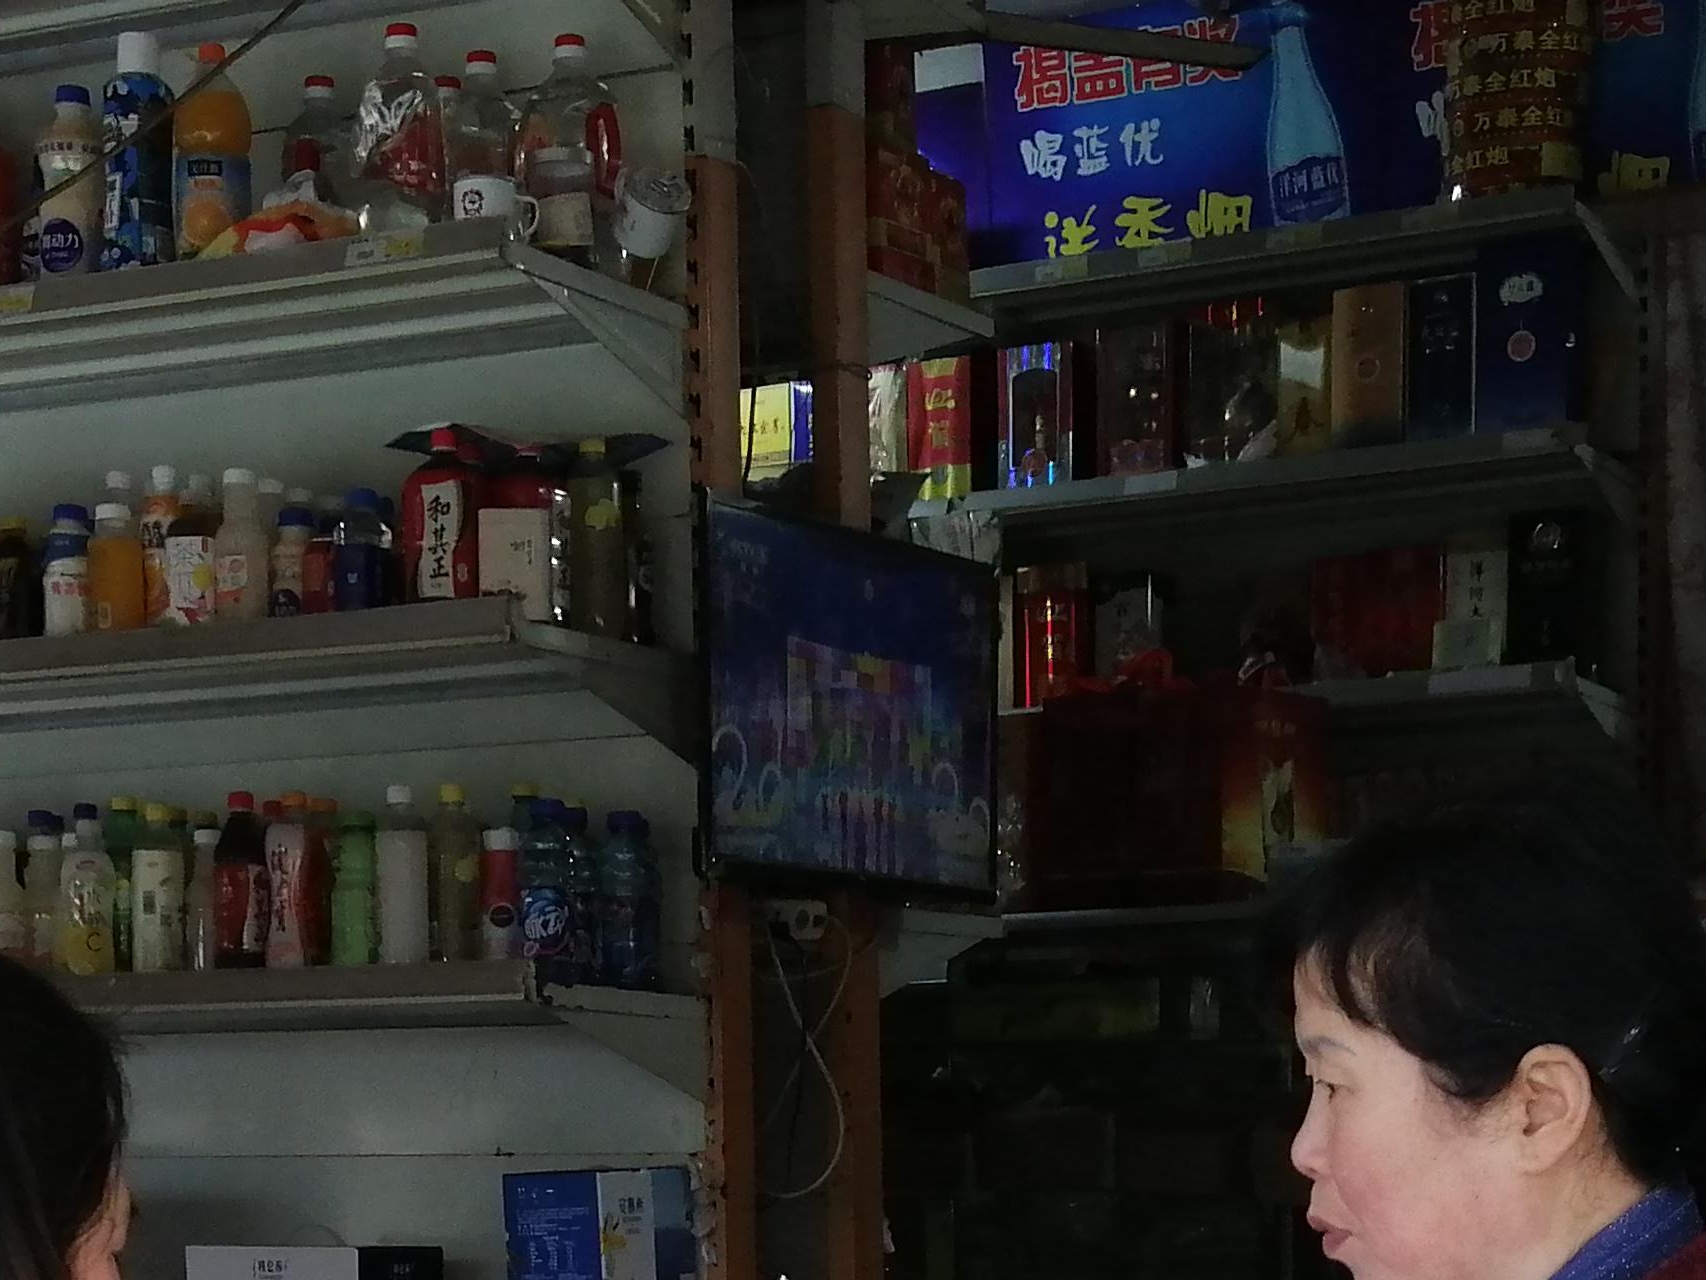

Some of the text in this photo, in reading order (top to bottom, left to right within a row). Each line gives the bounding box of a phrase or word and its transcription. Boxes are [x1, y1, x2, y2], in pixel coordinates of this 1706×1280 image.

[1019, 118, 1165, 181] 喝蓝优
[427, 493, 451, 580] 和其正
